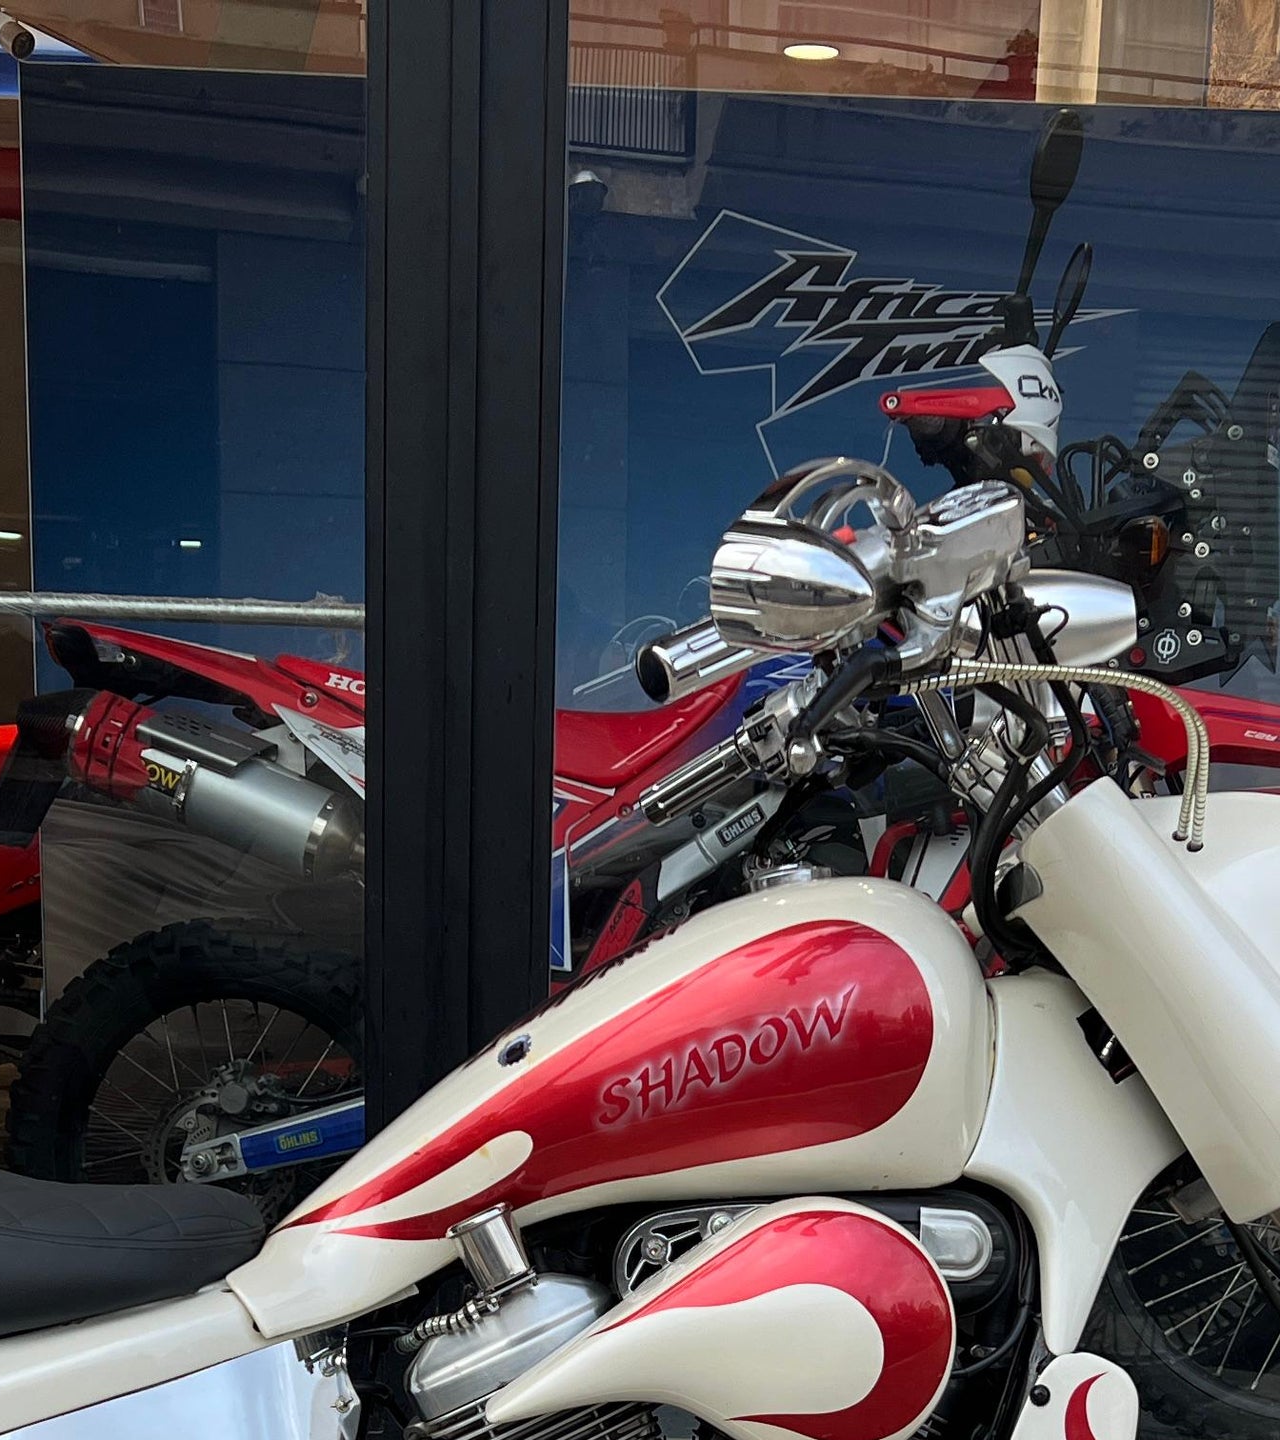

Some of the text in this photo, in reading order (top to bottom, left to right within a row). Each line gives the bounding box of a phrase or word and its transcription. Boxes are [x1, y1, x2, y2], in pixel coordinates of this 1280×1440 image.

[324, 672, 366, 696] HO
[147, 763, 181, 790] OW
[597, 983, 860, 1127] SHADOW
